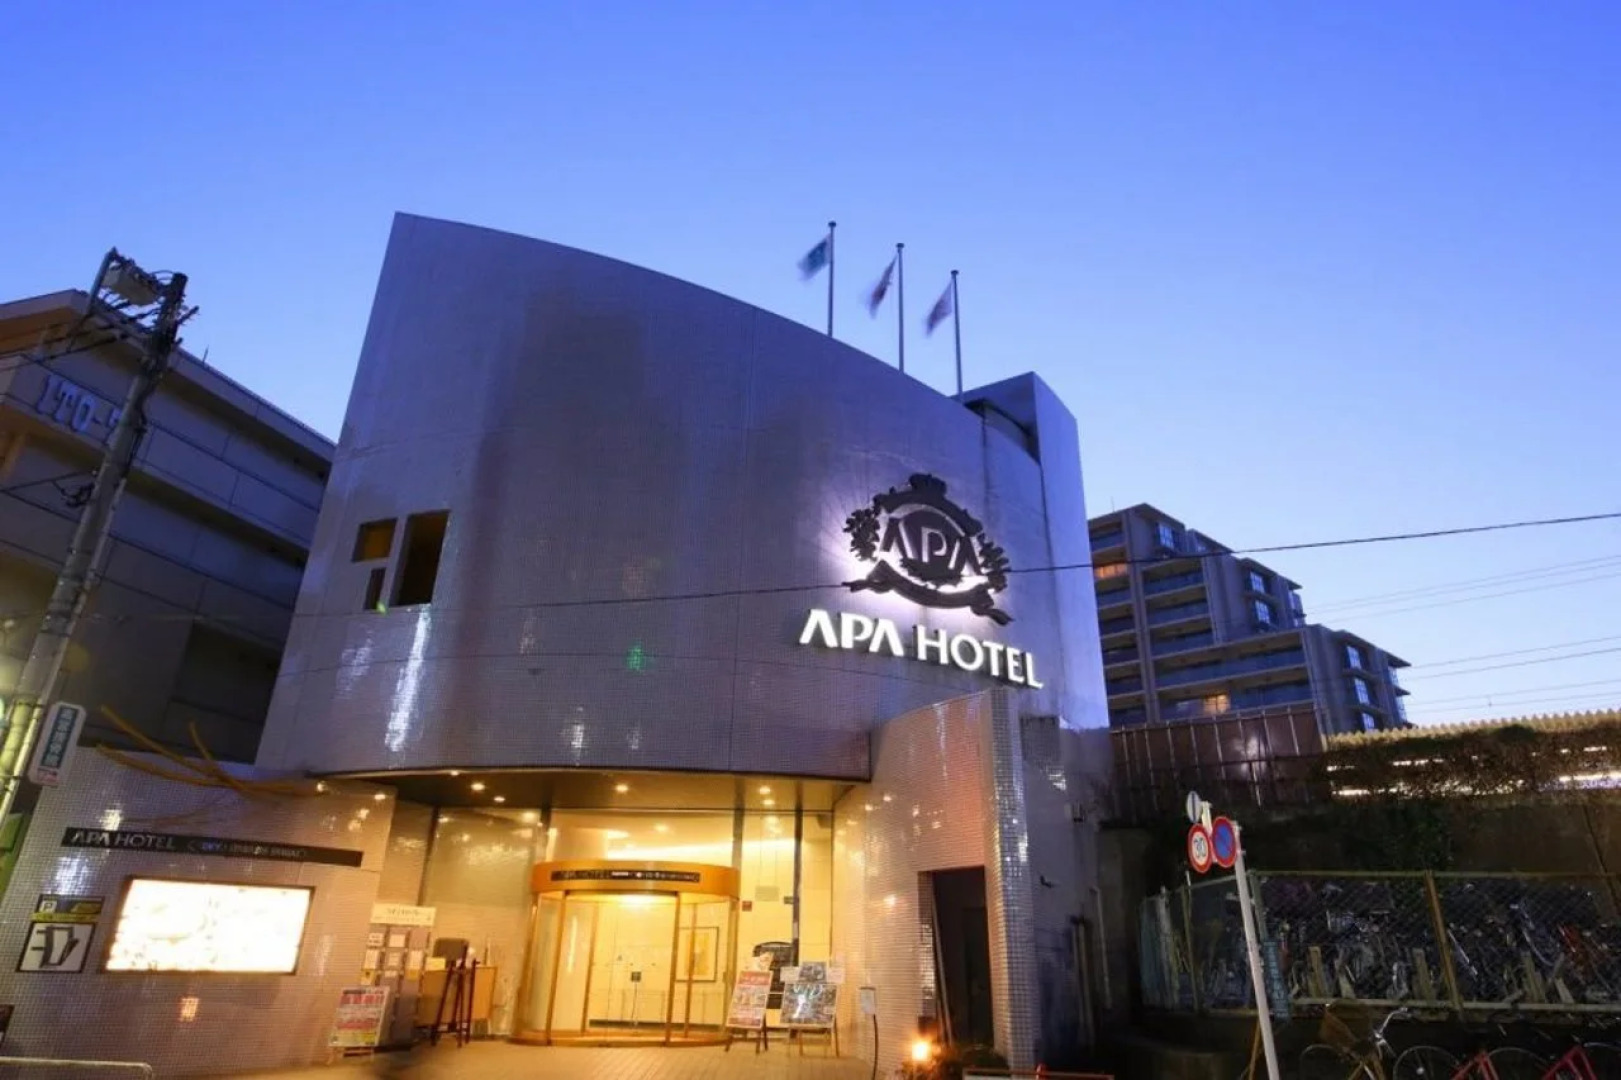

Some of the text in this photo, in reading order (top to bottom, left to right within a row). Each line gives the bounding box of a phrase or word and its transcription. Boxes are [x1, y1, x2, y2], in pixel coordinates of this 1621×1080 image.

[881, 516, 983, 577] APA
[799, 608, 1044, 689] APA HOTEL
[71, 830, 110, 847] APA
[114, 833, 178, 850] HOTEL
